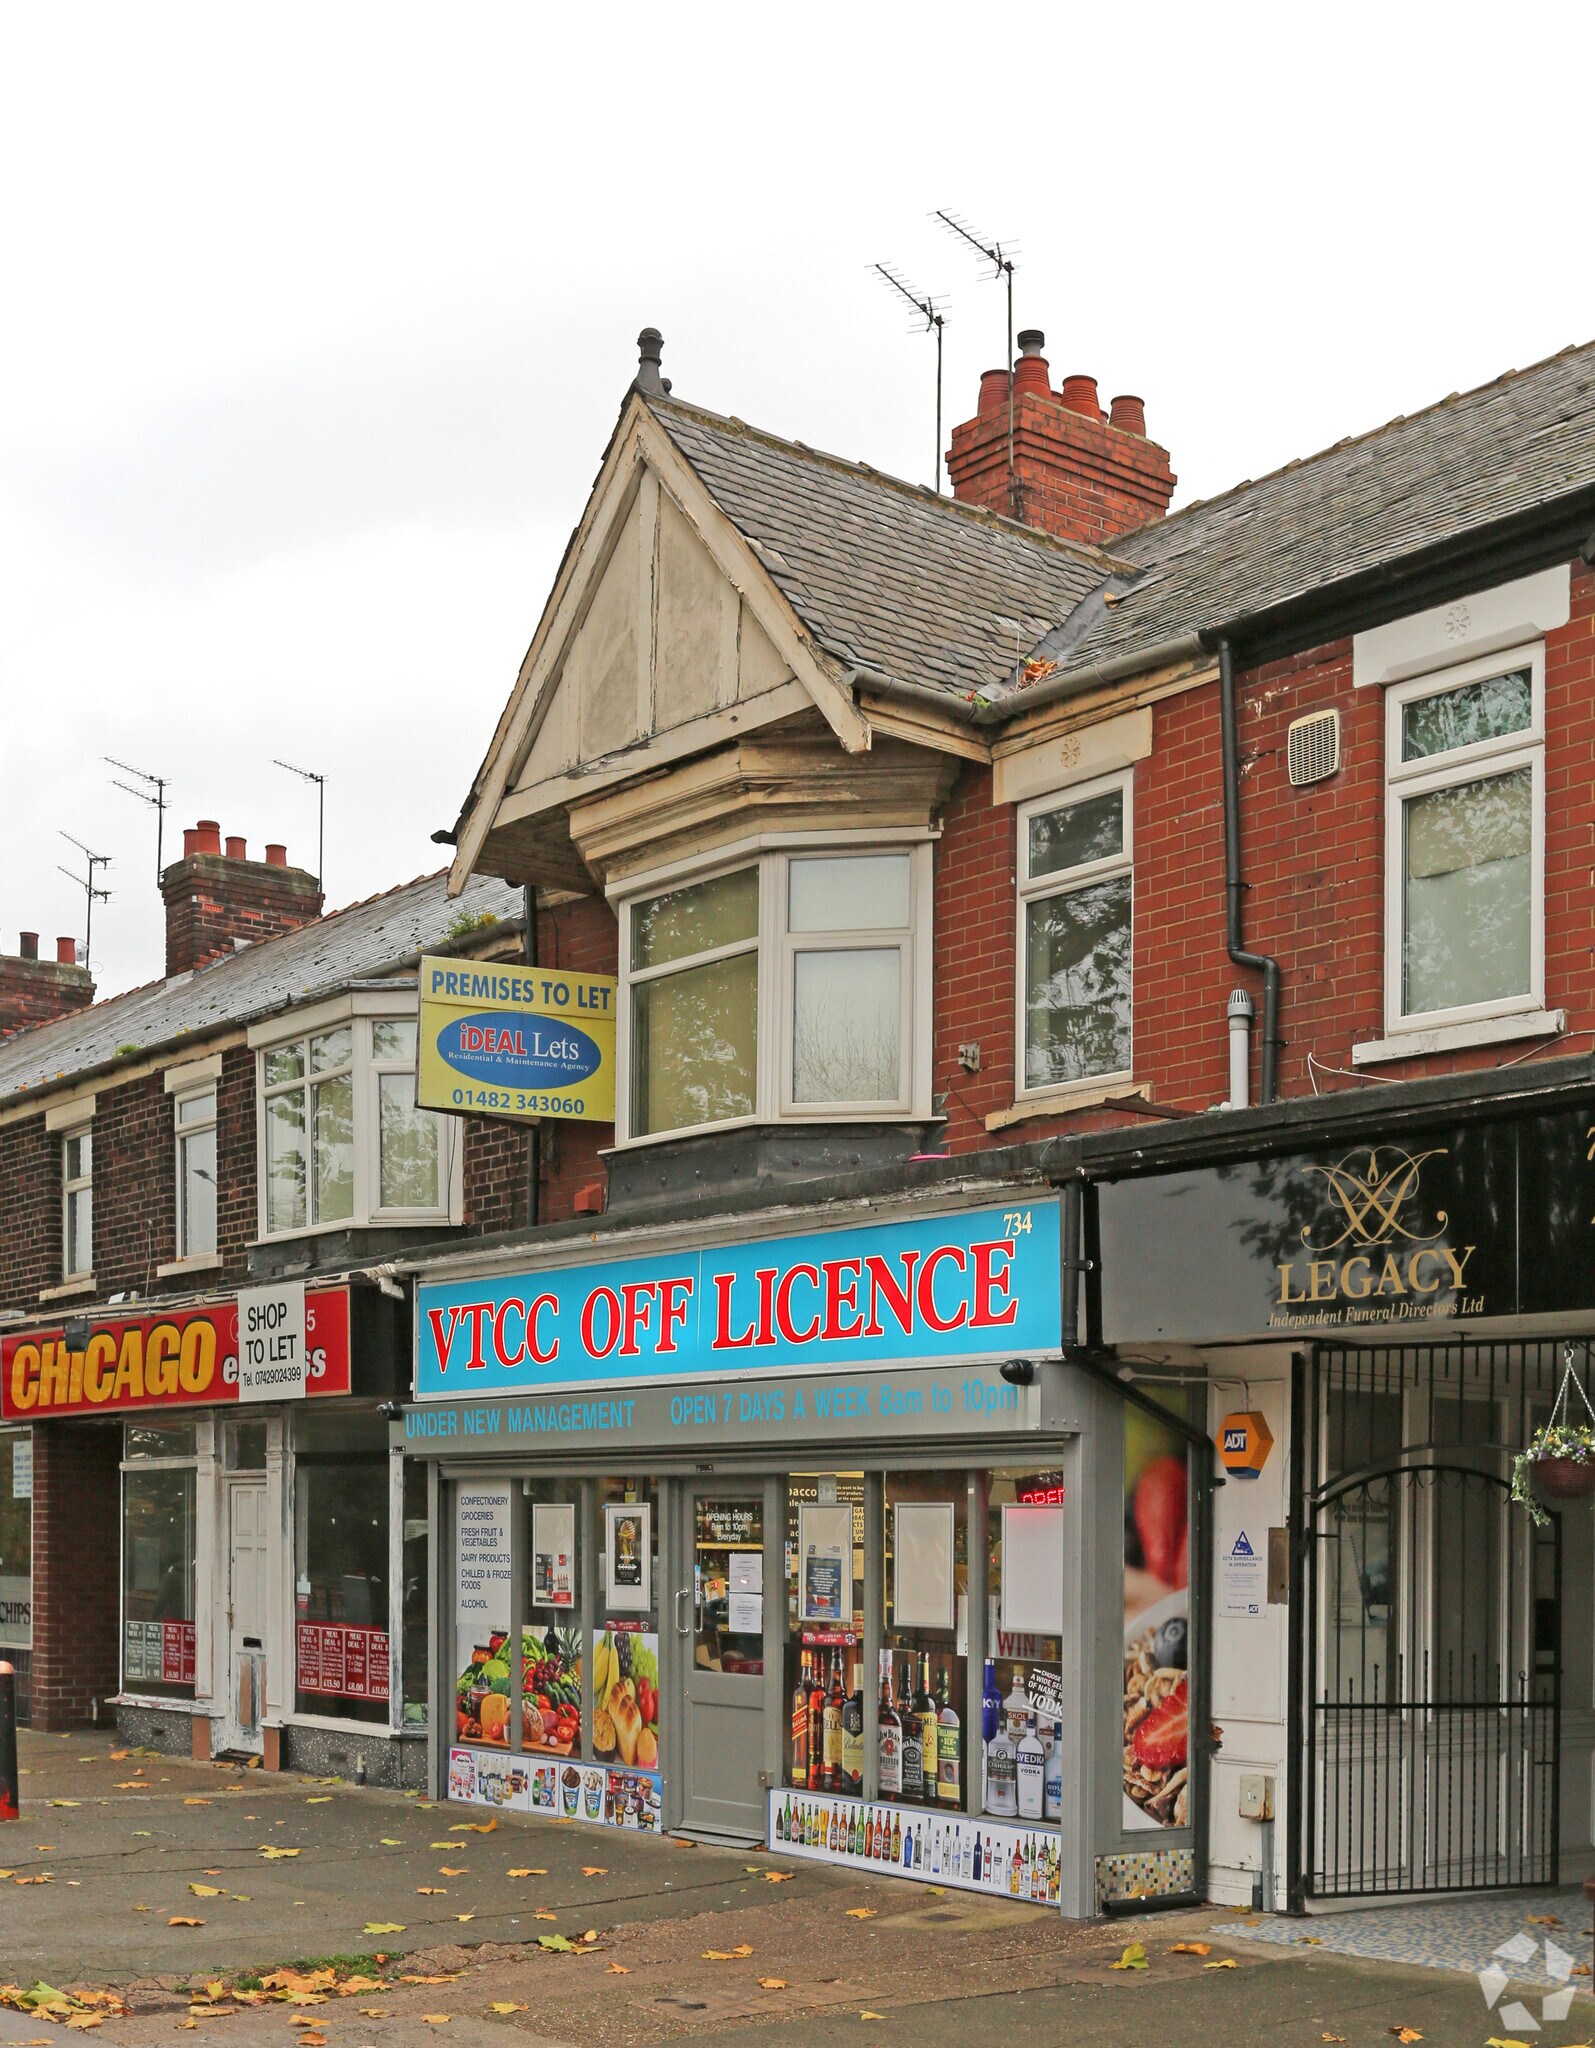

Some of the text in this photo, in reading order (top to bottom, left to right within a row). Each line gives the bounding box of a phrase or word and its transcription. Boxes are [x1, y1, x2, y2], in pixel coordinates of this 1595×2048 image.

[431, 970, 611, 1010] PREMISES TO LET
[460, 1023, 579, 1061] iDEAL Lets
[448, 1051, 493, 1062] Residential
[506, 1057, 558, 1068] Maintenance
[560, 1062, 590, 1072] Agency
[452, 1089, 585, 1115] 01482 343060
[1003, 1211, 1033, 1237] 734
[1276, 1246, 1476, 1304] LEGACY
[428, 1239, 1019, 1374] VTCC OFF LICENCE
[1269, 1296, 1485, 1330] Independent Funeral Directors Ltd
[248, 1302, 287, 1332] SHOP
[245, 1334, 297, 1365] TO LET
[243, 1372, 253, 1387] Tel.
[256, 1366, 302, 1386] 07429024399
[405, 1378, 1018, 1438] UNDER NEW MANAGEMENT OPEN 7 DAYS A WEEK 8am to 10pm
[1225, 1432, 1246, 1450] ADT
[461, 1496, 508, 1505] CONFECTIONERY
[461, 1511, 494, 1520] GROCERIES
[706, 1512, 753, 1521] OPENING HOURS
[461, 1528, 503, 1536] FRESH FRUIT &
[711, 1523, 724, 1531] 8am
[732, 1523, 747, 1532] 10pm
[461, 1538, 498, 1546] VEGETABLES
[717, 1533, 741, 1543] Everyday
[461, 1553, 510, 1563] DAIRY PRODUCTS
[461, 1569, 485, 1578] CHILLED
[487, 1570, 491, 1578] &
[461, 1581, 481, 1589] FOODS
[461, 1599, 488, 1608] ALCOHOL
[997, 1629, 1035, 1657] WIN
[1037, 1676, 1051, 1686] WIDE
[1041, 1670, 1061, 1681] CHOOSE
[1028, 1680, 1037, 1689] OF
[1038, 1684, 1056, 1697] NAME
[1007, 1712, 1026, 1720] SKOL
